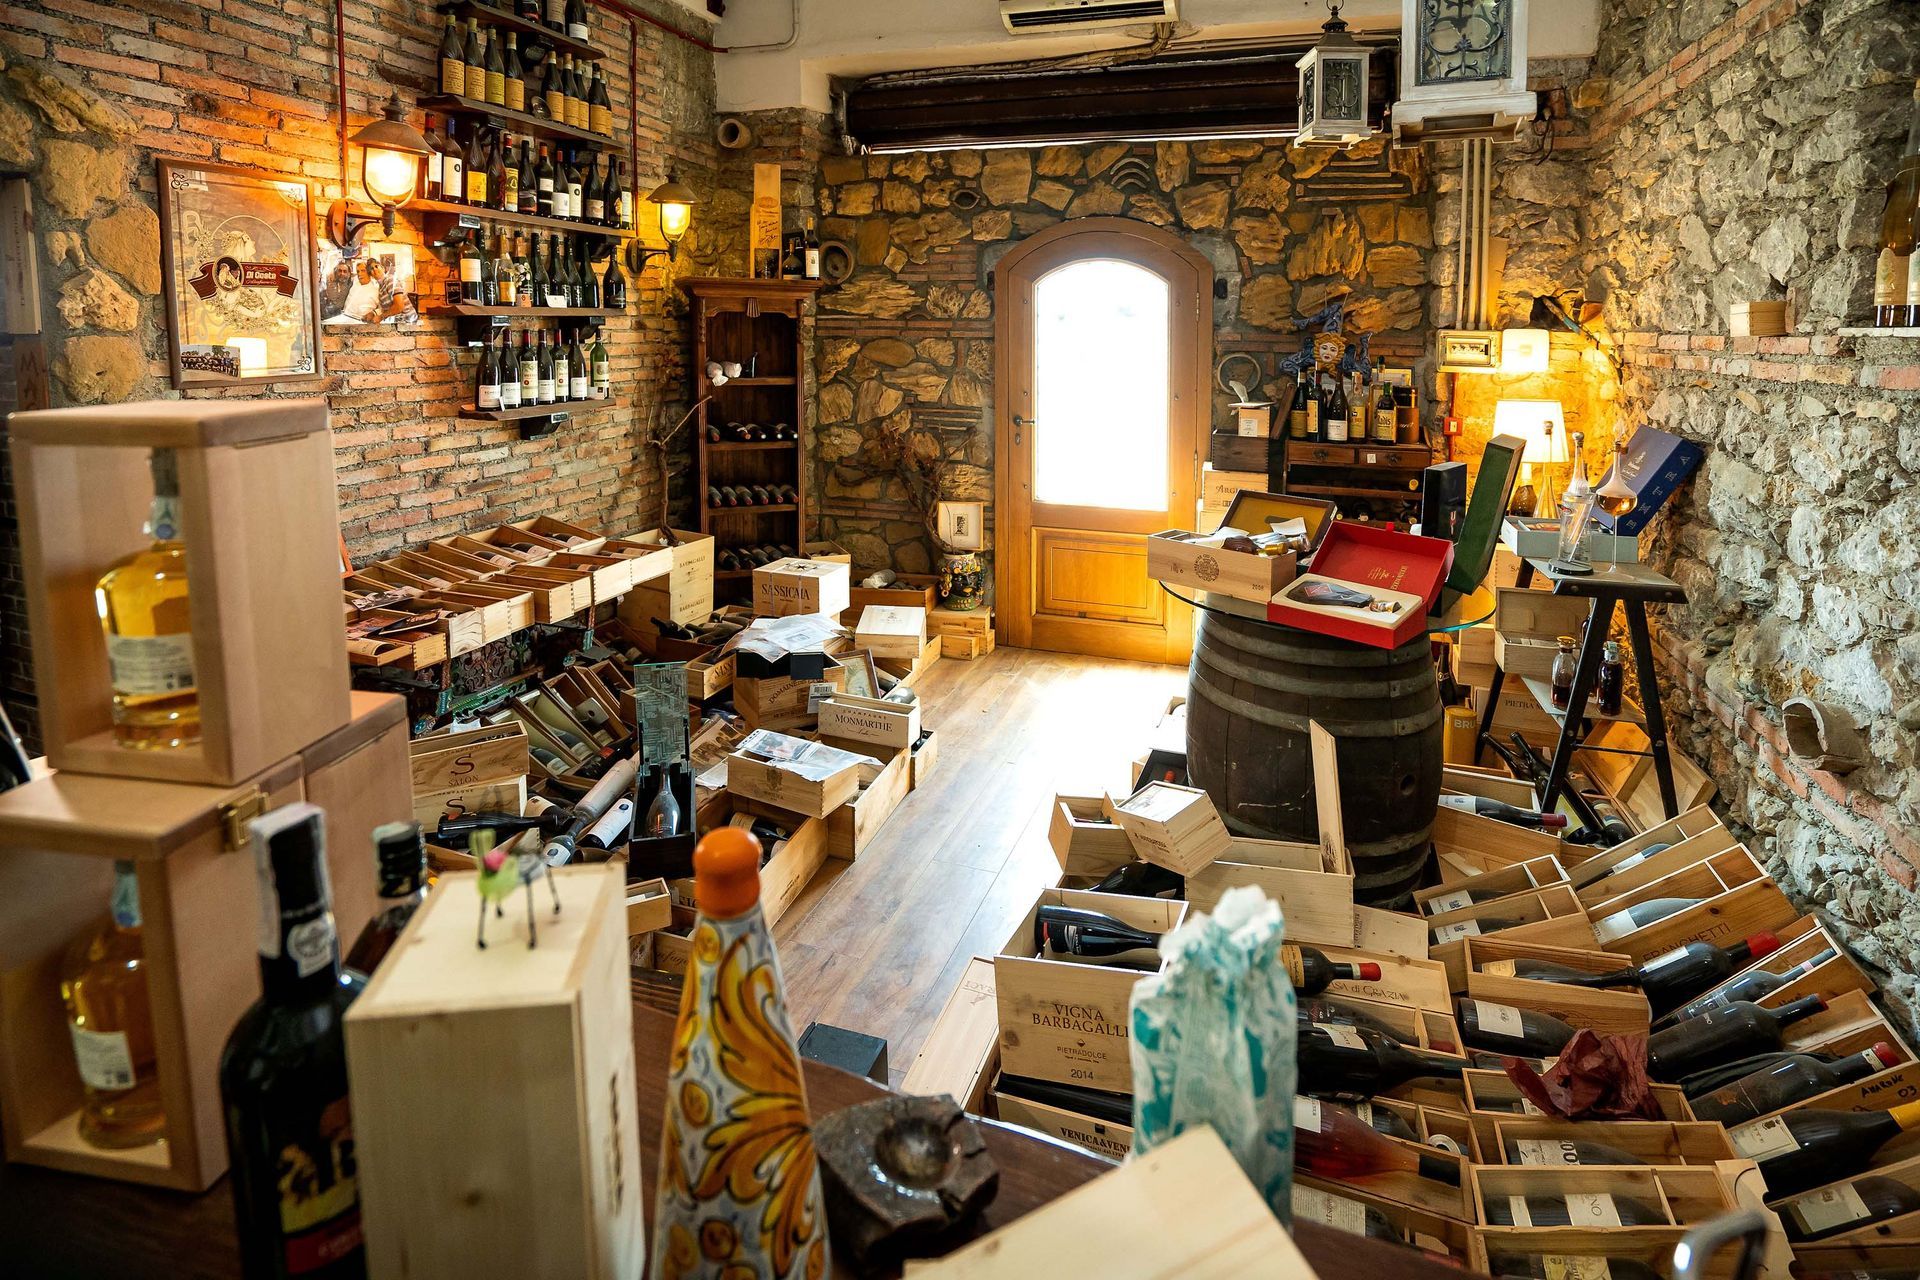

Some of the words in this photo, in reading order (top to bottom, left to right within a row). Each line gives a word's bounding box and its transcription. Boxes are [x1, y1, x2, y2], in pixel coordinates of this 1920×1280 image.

[834, 713, 893, 733] MONMARTHE
[450, 753, 475, 776] S
[448, 774, 480, 788] SALON
[1351, 984, 1360, 993] di
[1054, 1003, 1105, 1022] VIGNA
[1032, 1013, 1129, 1038] BARBAGALLI
[1056, 1046, 1107, 1060] PIETRADOLCE
[1070, 1068, 1094, 1081] 2014
